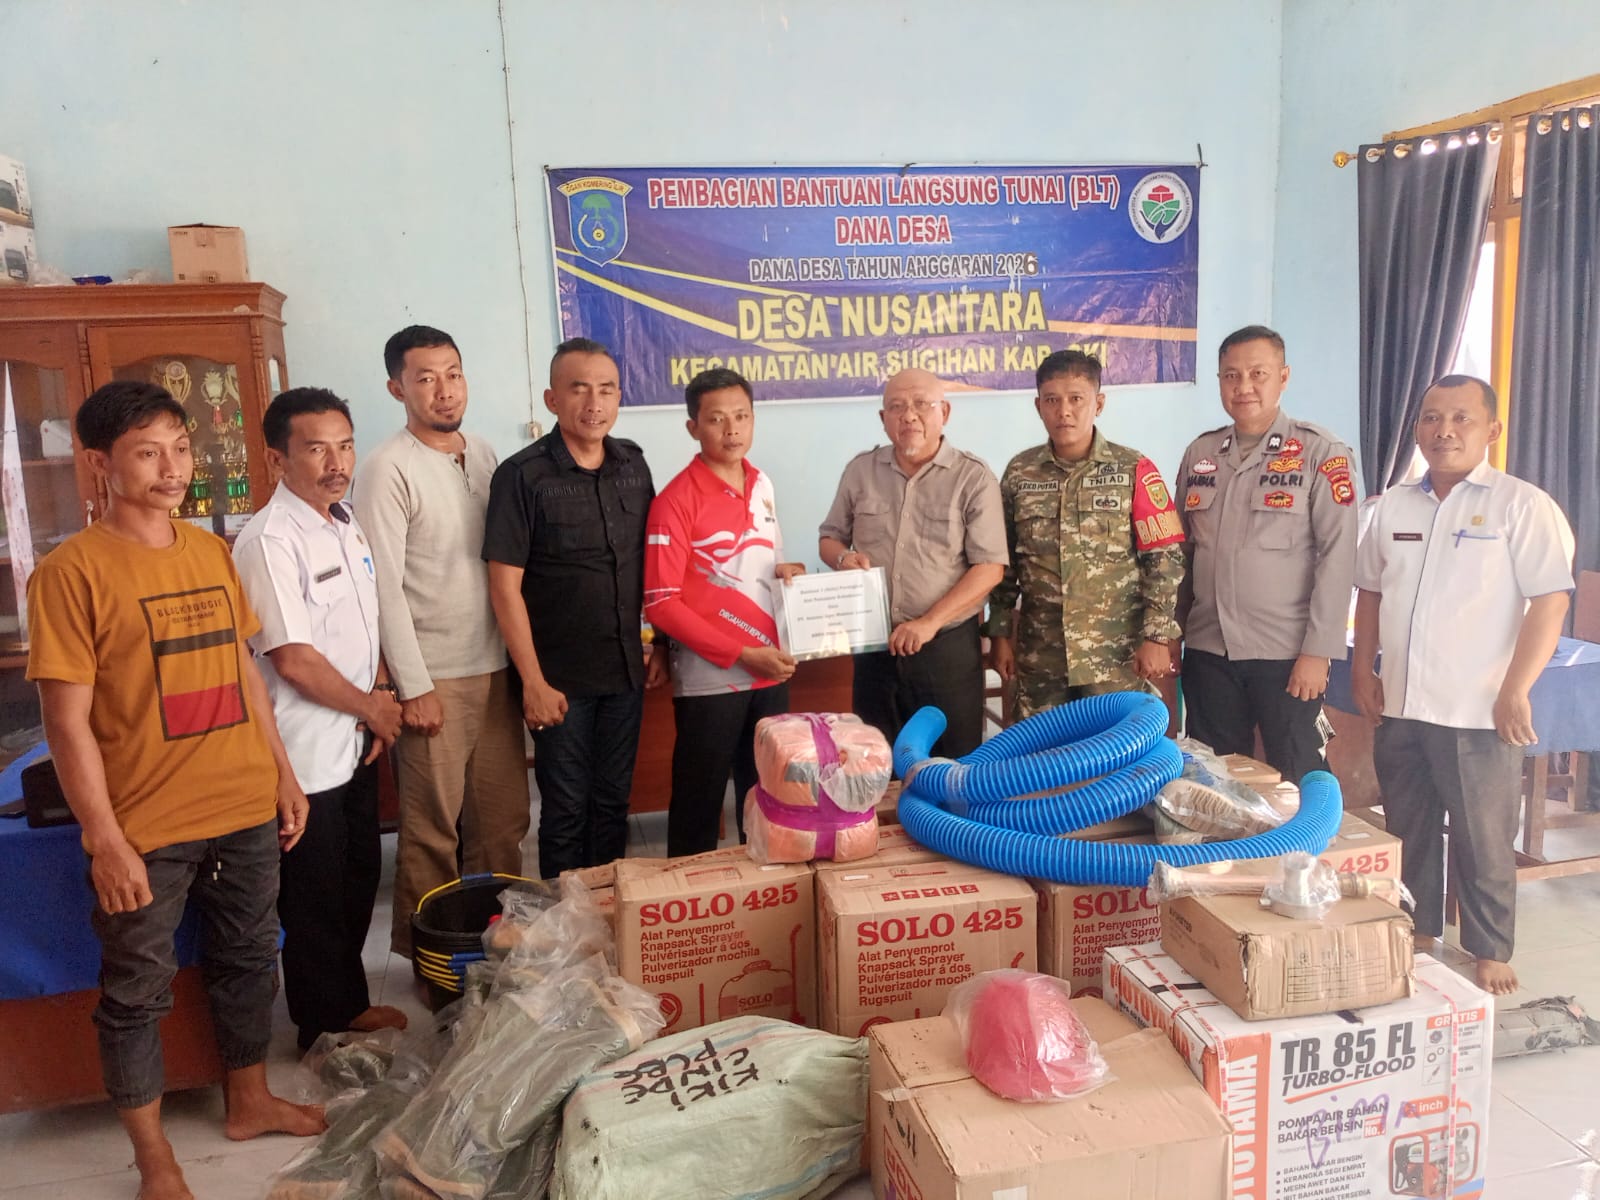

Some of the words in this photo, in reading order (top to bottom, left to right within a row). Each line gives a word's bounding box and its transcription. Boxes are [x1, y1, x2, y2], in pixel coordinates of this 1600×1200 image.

[649, 178, 778, 208] PEMBAGIAN
[782, 176, 881, 206] BANTUAN
[888, 175, 998, 206] LANGSUNG
[1002, 174, 1064, 204] TUNAI
[1069, 174, 1120, 210] (BLT)
[835, 217, 893, 245] DANA
[897, 215, 952, 244] DESA
[750, 258, 796, 282] DANA
[800, 257, 843, 280] DESA
[846, 256, 901, 279] TAHUN
[906, 254, 993, 278] ANGGARAN
[996, 252, 1039, 277] 2026
[738, 297, 832, 340] DESA
[841, 291, 1048, 338] NUSANTARA
[836, 351, 879, 378] AIR
[886, 347, 996, 377] SUGIHAN
[1088, 477, 1106, 486] TNI
[1259, 474, 1303, 487] POLRI
[1339, 851, 1390, 875] 425
[639, 893, 735, 927] SOLO
[742, 882, 799, 911] 425
[640, 931, 663, 942] Alat
[666, 920, 735, 939] Penyemprot
[857, 913, 955, 947] SOLO
[963, 906, 1023, 934] 425
[1073, 924, 1095, 934] Alat
[1098, 915, 1160, 933] Penyempro
[641, 936, 698, 953] Knapsack
[700, 929, 745, 947] Sprayer
[1073, 930, 1127, 946] Knapsack
[1130, 926, 1161, 941] Spray
[641, 944, 718, 964] Pulvérisateur
[730, 940, 750, 950] dos
[641, 956, 714, 974] Pulverizador
[716, 947, 760, 962] mochila
[857, 951, 881, 963] Alat
[884, 941, 955, 959] Penyemprot
[858, 958, 916, 975] Knapsack
[919, 953, 965, 969] Sprayer
[858, 967, 937, 985] Pulvérisateur
[949, 962, 971, 973] dos
[1073, 967, 1101, 977] Rugs
[642, 969, 695, 985] Rugspuit
[858, 978, 932, 996] Pulverizador
[935, 972, 975, 987] moch
[738, 992, 773, 1007] SOLO
[859, 991, 913, 1007] Rugspuit
[1434, 1011, 1479, 1027] GRATIS
[1280, 1037, 1321, 1076] TR
[1333, 1028, 1377, 1068] 85
[1386, 1021, 1416, 1058] FL
[1281, 1055, 1416, 1097] TURBO-FLOOD
[1278, 1114, 1320, 1131] POMPA
[1323, 1110, 1343, 1122] AIR
[1346, 1101, 1388, 1118] BAHAN
[1419, 1100, 1443, 1113] inch
[1278, 1127, 1318, 1144] BAKAR
[1320, 1120, 1363, 1136] BENSIN
[1365, 1124, 1385, 1137] NO.
[1283, 1164, 1309, 1175] BAHAN
[1337, 1154, 1363, 1165] BENSIN
[1283, 1170, 1324, 1184] KERANGKA
[1324, 1167, 1341, 1176] SEGI
[1342, 1162, 1366, 1172] EMPAT
[1283, 1182, 1306, 1193] MESIN
[1307, 1178, 1329, 1188] AWET
[1329, 1175, 1345, 1184] DAN
[1346, 1171, 1366, 1181] KUAT
[1298, 1188, 1324, 1199] BAHAN
[1325, 1183, 1350, 1194] BAKAR
